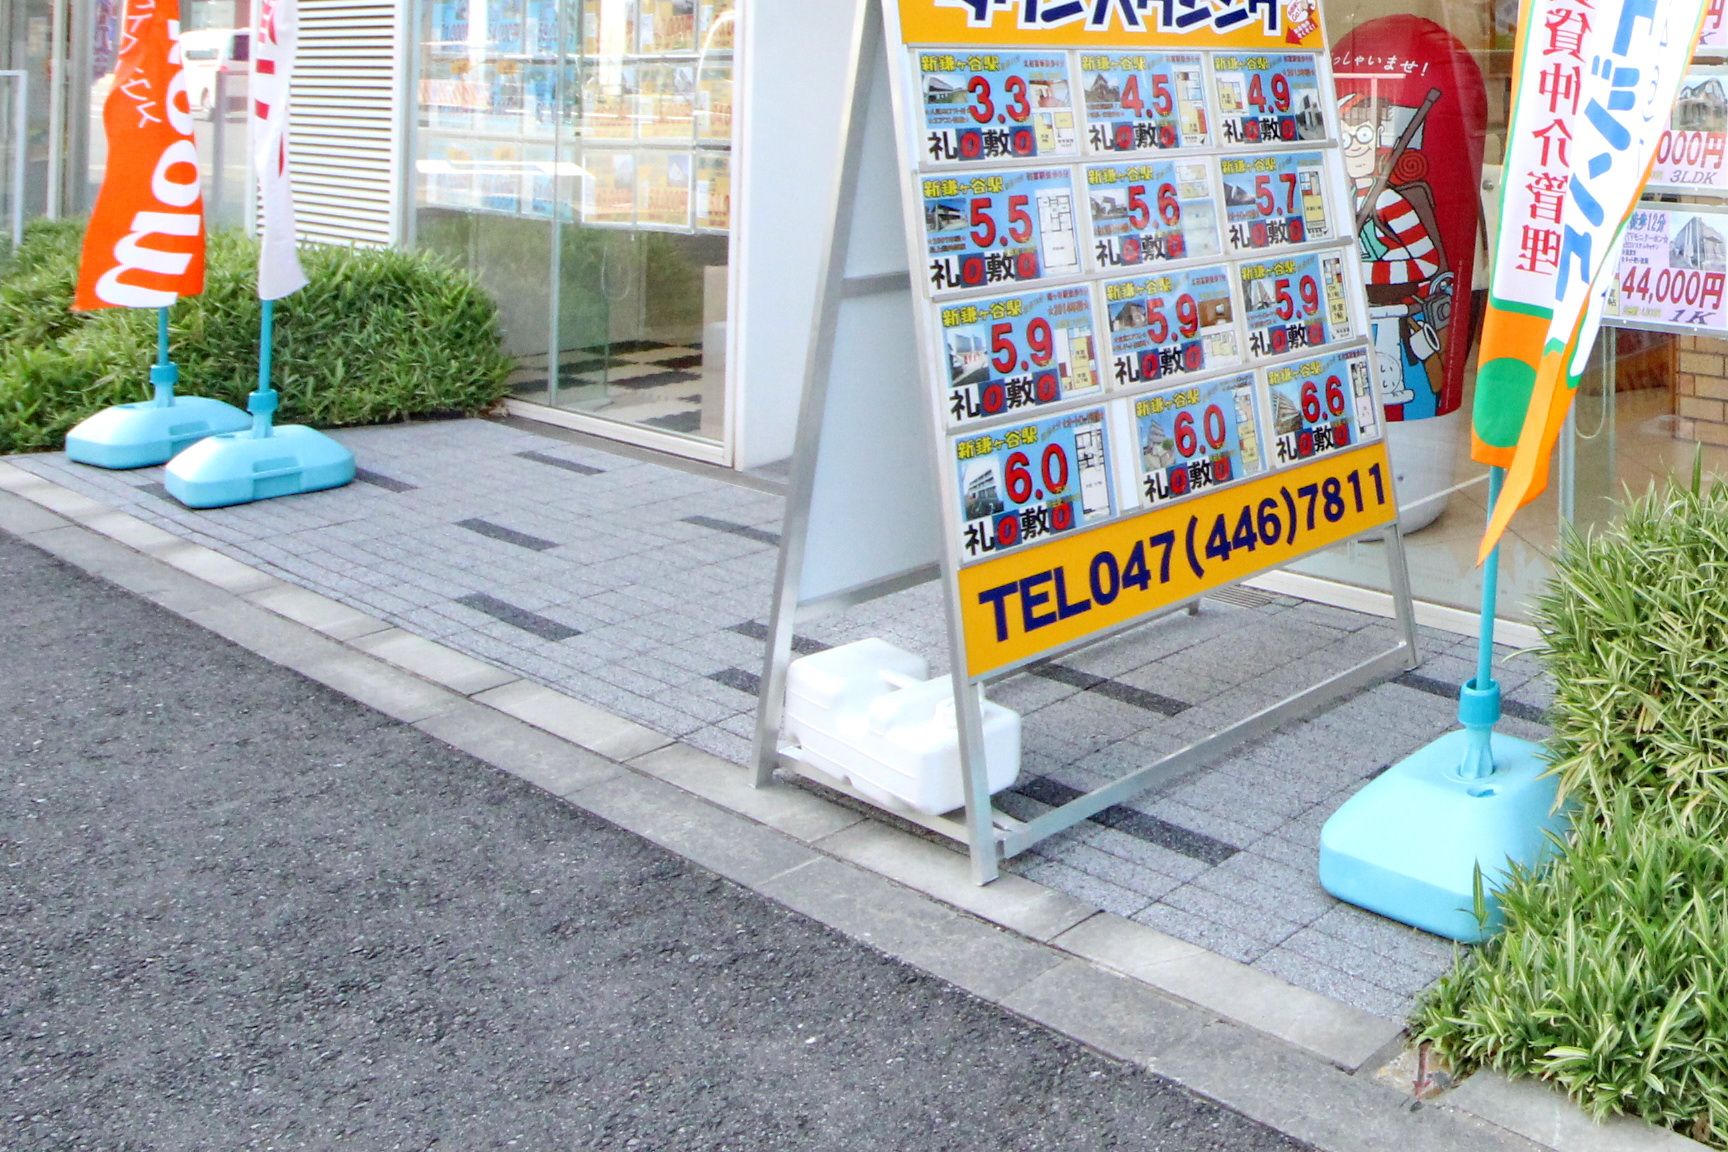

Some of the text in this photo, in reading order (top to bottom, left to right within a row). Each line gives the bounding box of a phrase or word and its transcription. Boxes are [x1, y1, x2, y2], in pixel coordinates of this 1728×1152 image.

[1332, 50, 1429, 78] っしゃいませ!
[968, 75, 1031, 124] 3.3
[1121, 74, 1173, 119] 4.5
[1248, 73, 1290, 114] 4.9
[1656, 130, 1728, 169] 000円
[1255, 173, 1297, 216] 5.7
[1669, 169, 1718, 184] 3LDK
[970, 195, 1033, 247] 5.5
[1128, 183, 1180, 230] 5.6
[1629, 211, 1667, 233] 徒歩12分
[1275, 274, 1318, 321] 5.9
[1621, 266, 1726, 310] 44,000円
[1147, 293, 1199, 344] 5.9
[1669, 309, 1716, 325] 1K
[991, 317, 1053, 374] 5.9
[1300, 375, 1345, 424] 6.6
[1174, 404, 1226, 458] 6.0
[1004, 443, 1069, 504] 6.0
[978, 462, 1386, 643] TEL047(446)7811
